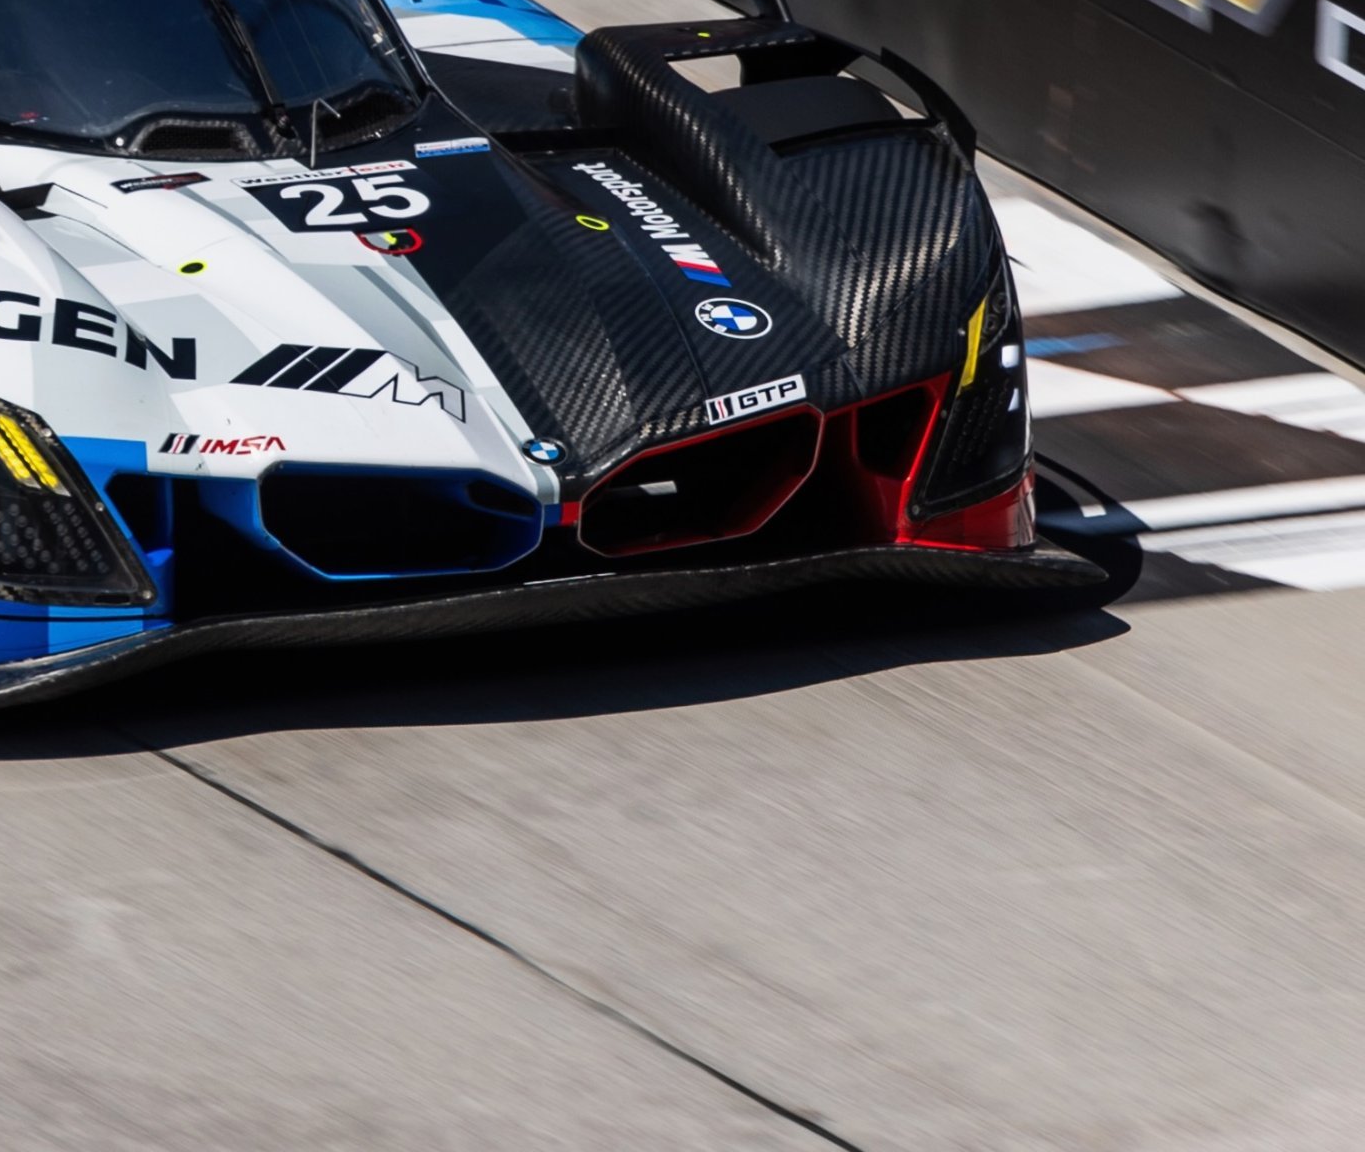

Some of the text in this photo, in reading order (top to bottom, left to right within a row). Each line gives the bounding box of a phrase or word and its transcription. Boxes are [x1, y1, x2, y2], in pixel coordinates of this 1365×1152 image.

[240, 160, 406, 185] WeatherTech
[279, 173, 430, 226] 25
[572, 161, 690, 240] Motorsport
[737, 379, 799, 412] GTP
[199, 435, 287, 457] IMSA
